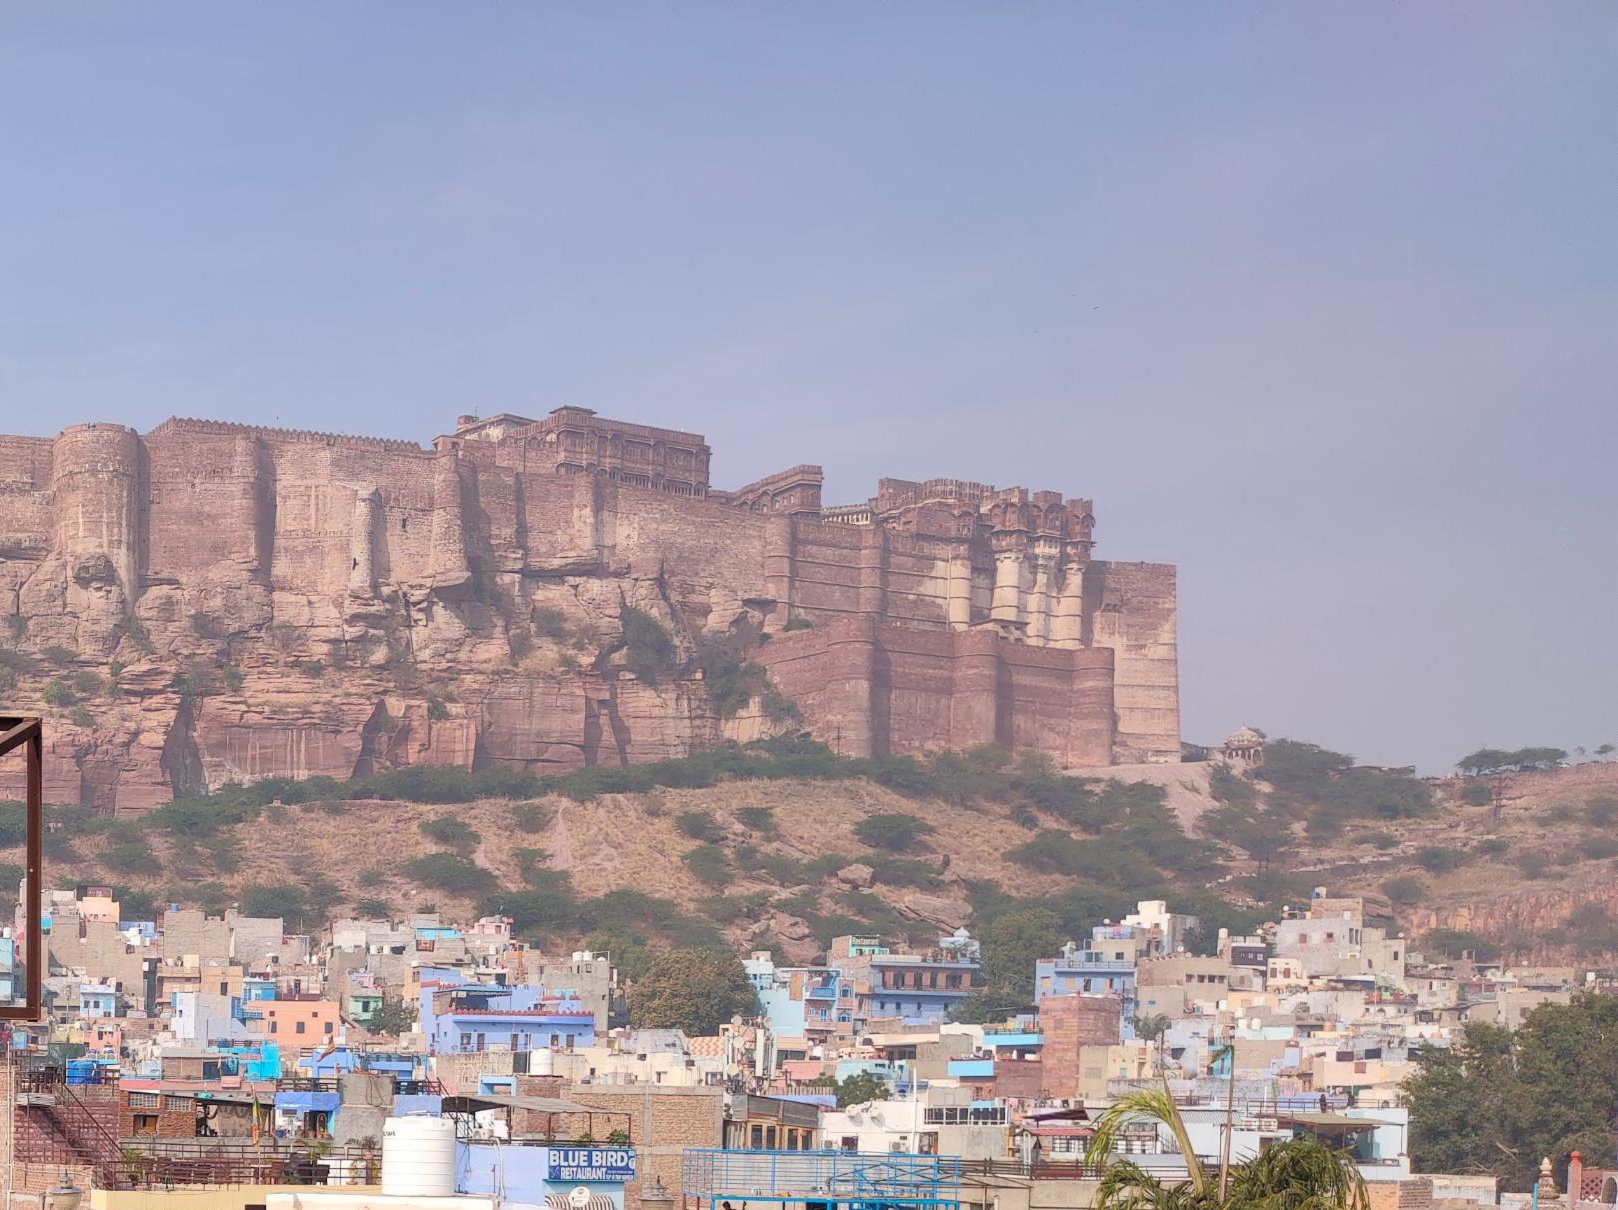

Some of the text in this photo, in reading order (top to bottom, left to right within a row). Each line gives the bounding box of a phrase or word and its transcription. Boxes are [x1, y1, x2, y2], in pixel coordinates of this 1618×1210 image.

[549, 1150, 628, 1167] BLUE BIRD
[560, 1167, 607, 1180] RESTAURANT
